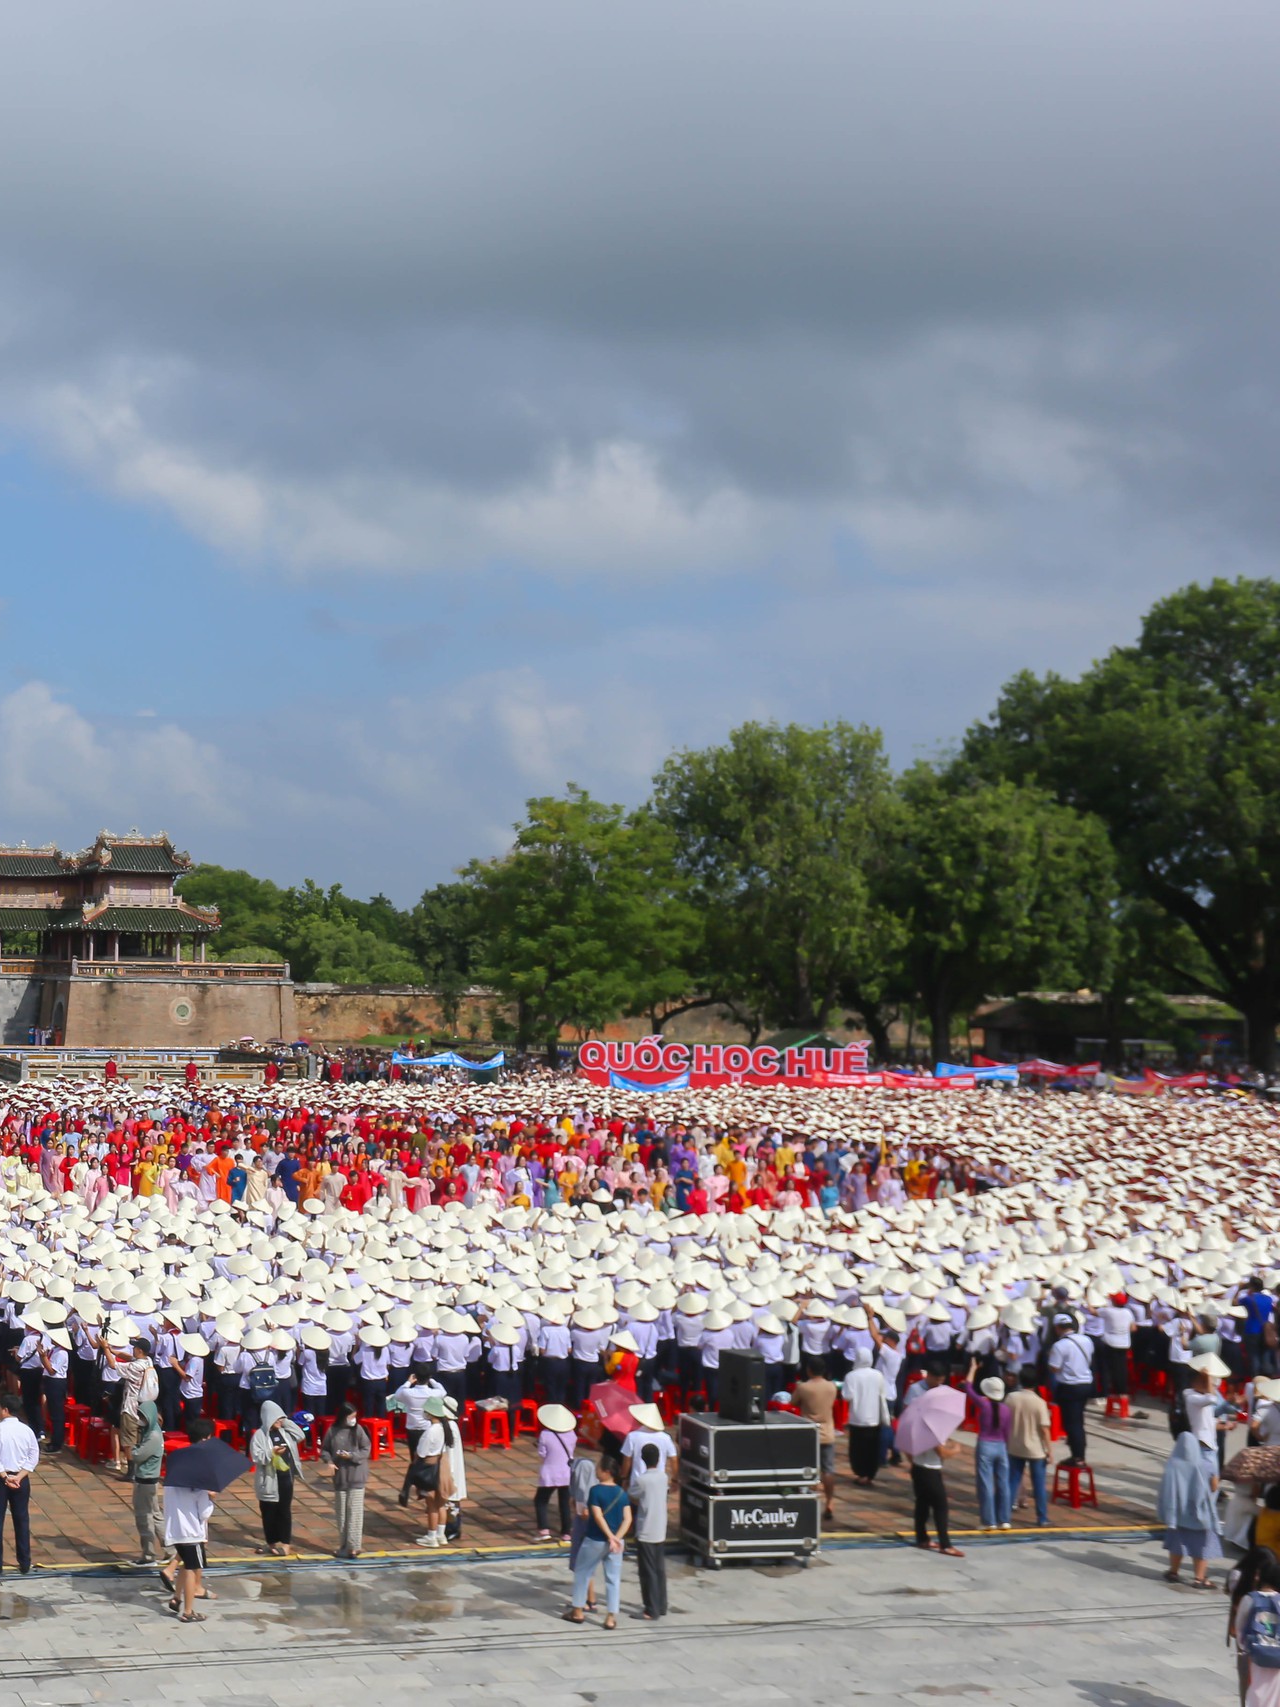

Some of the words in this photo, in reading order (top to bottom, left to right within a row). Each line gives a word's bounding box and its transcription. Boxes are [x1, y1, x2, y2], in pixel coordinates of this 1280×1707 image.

[579, 1035, 690, 1073] QUỐC
[694, 1044, 780, 1083] HỌC
[786, 1040, 872, 1076] HUẾ
[731, 1508, 799, 1527] McCauley
